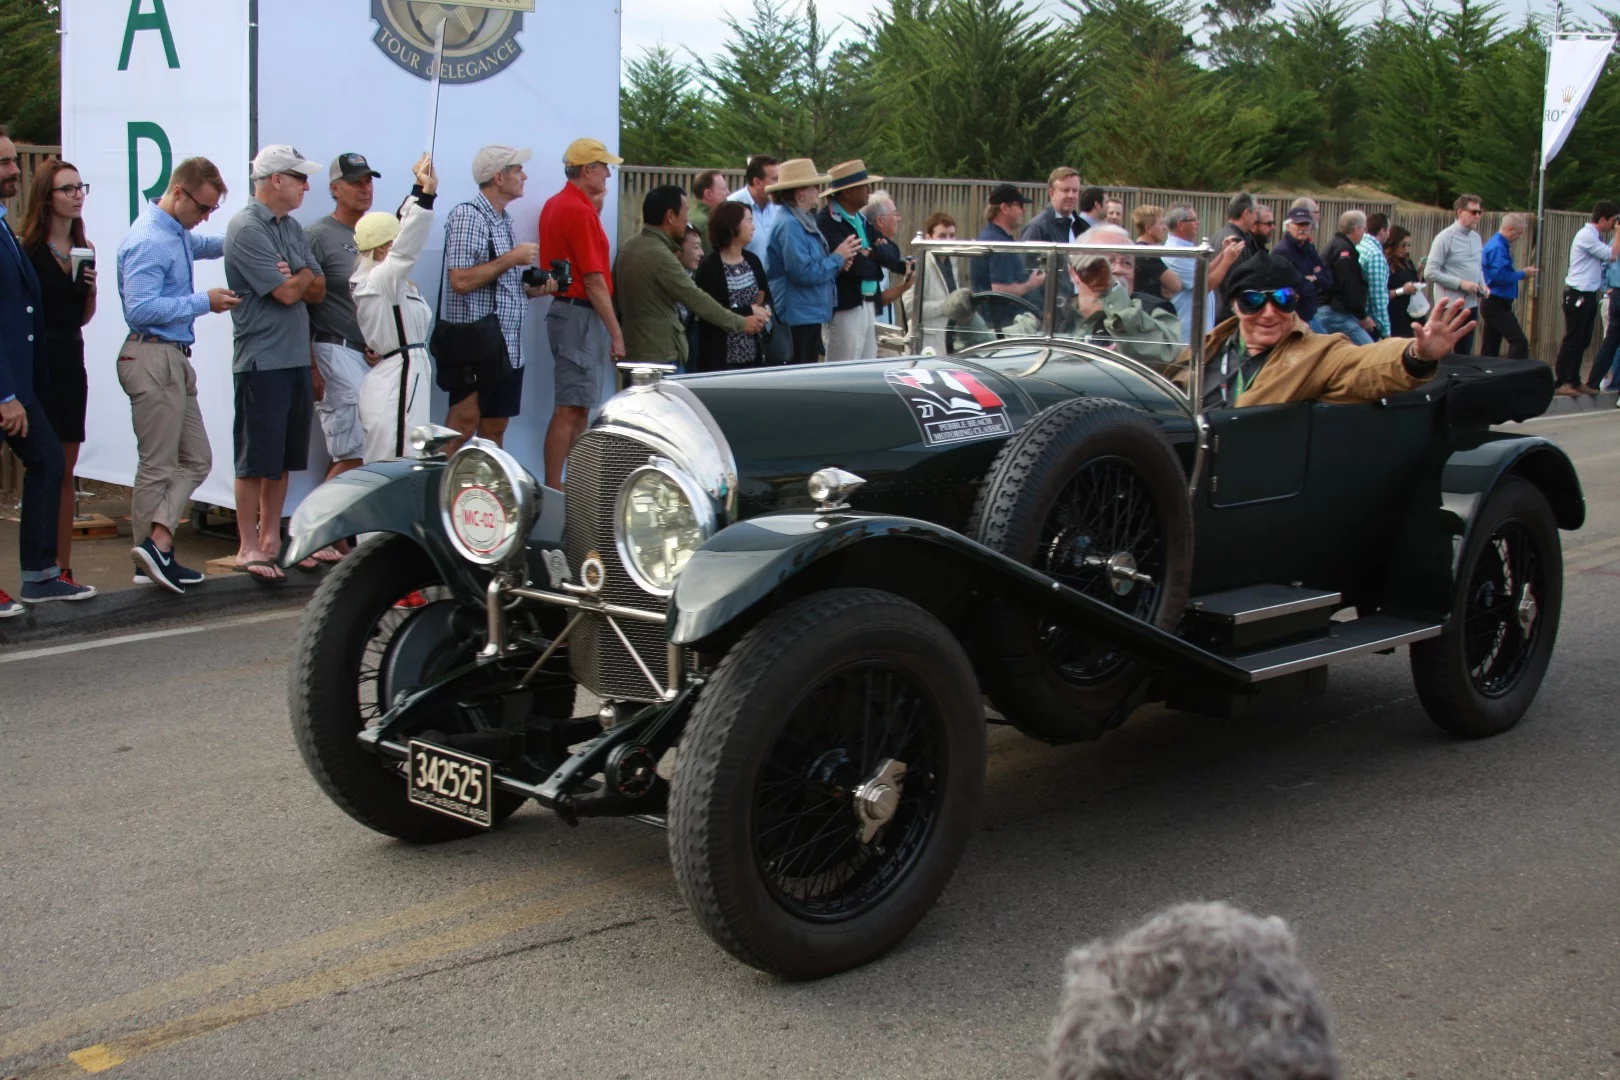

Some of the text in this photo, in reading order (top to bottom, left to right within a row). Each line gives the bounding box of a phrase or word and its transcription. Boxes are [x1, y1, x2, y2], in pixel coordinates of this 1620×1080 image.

[379, 28, 517, 79] TOUR dELEGANCE
[917, 404, 934, 418] 27
[933, 424, 1003, 441] MOTORING CLASSIC
[939, 417, 993, 431] PEBBLE BEACH
[463, 510, 495, 529] MC-02
[416, 753, 482, 804] 342525
